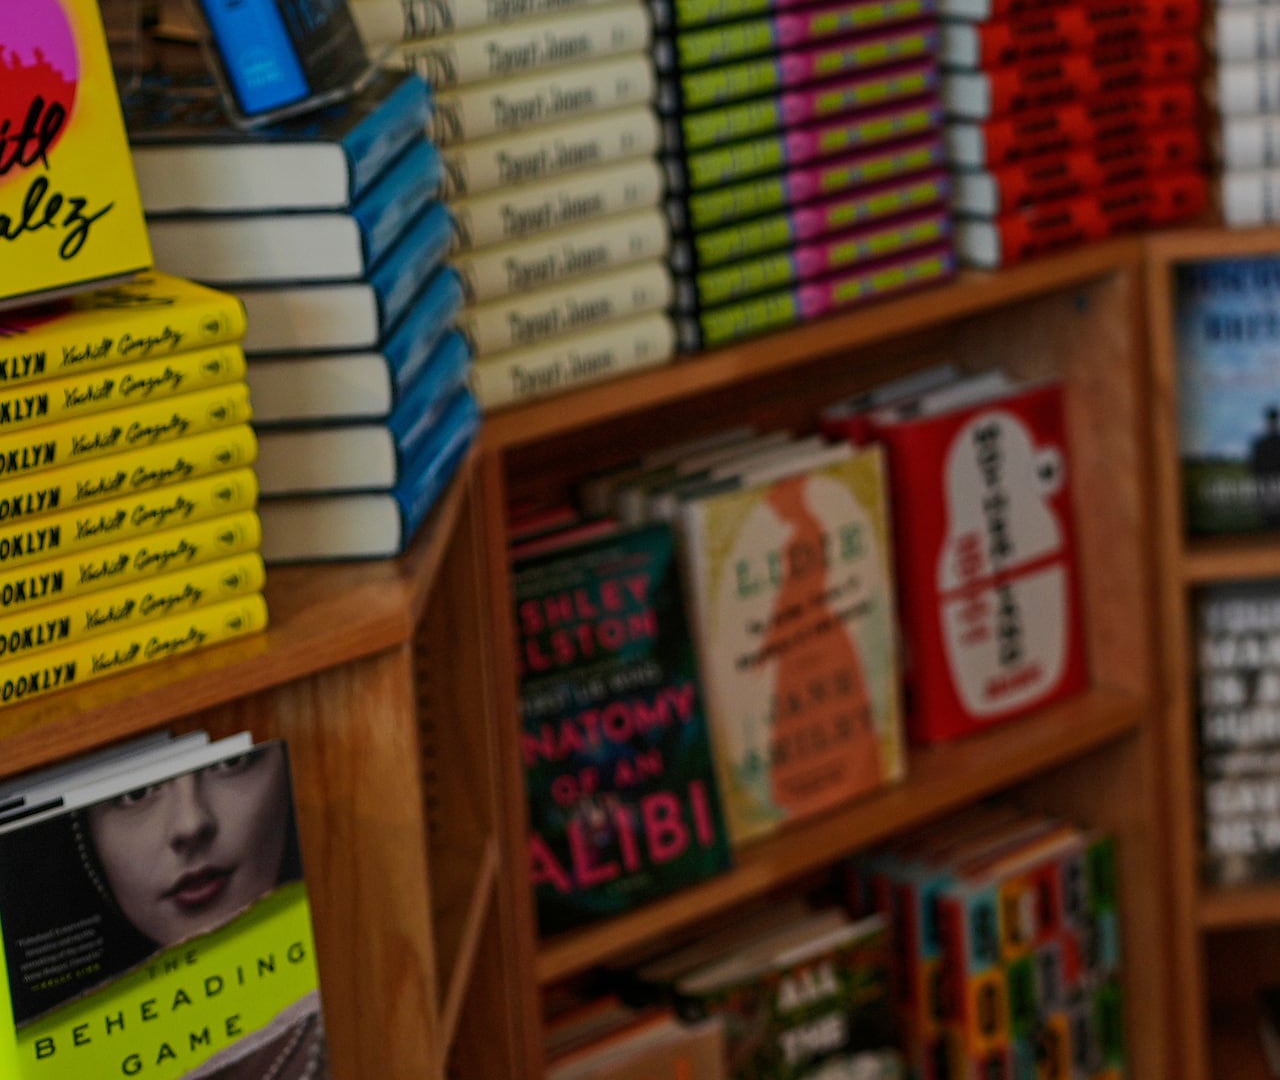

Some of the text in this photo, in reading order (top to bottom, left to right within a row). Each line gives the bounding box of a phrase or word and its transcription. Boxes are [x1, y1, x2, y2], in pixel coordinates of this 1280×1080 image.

[1, 393, 48, 423] KLYN
[3, 571, 64, 607] OKLYN
[518, 608, 660, 670] LSTON
[529, 779, 715, 895] ALIBI
[146, 949, 199, 980] THE
[34, 941, 306, 1061] BEHEADING
[121, 1014, 243, 1077] GAME
